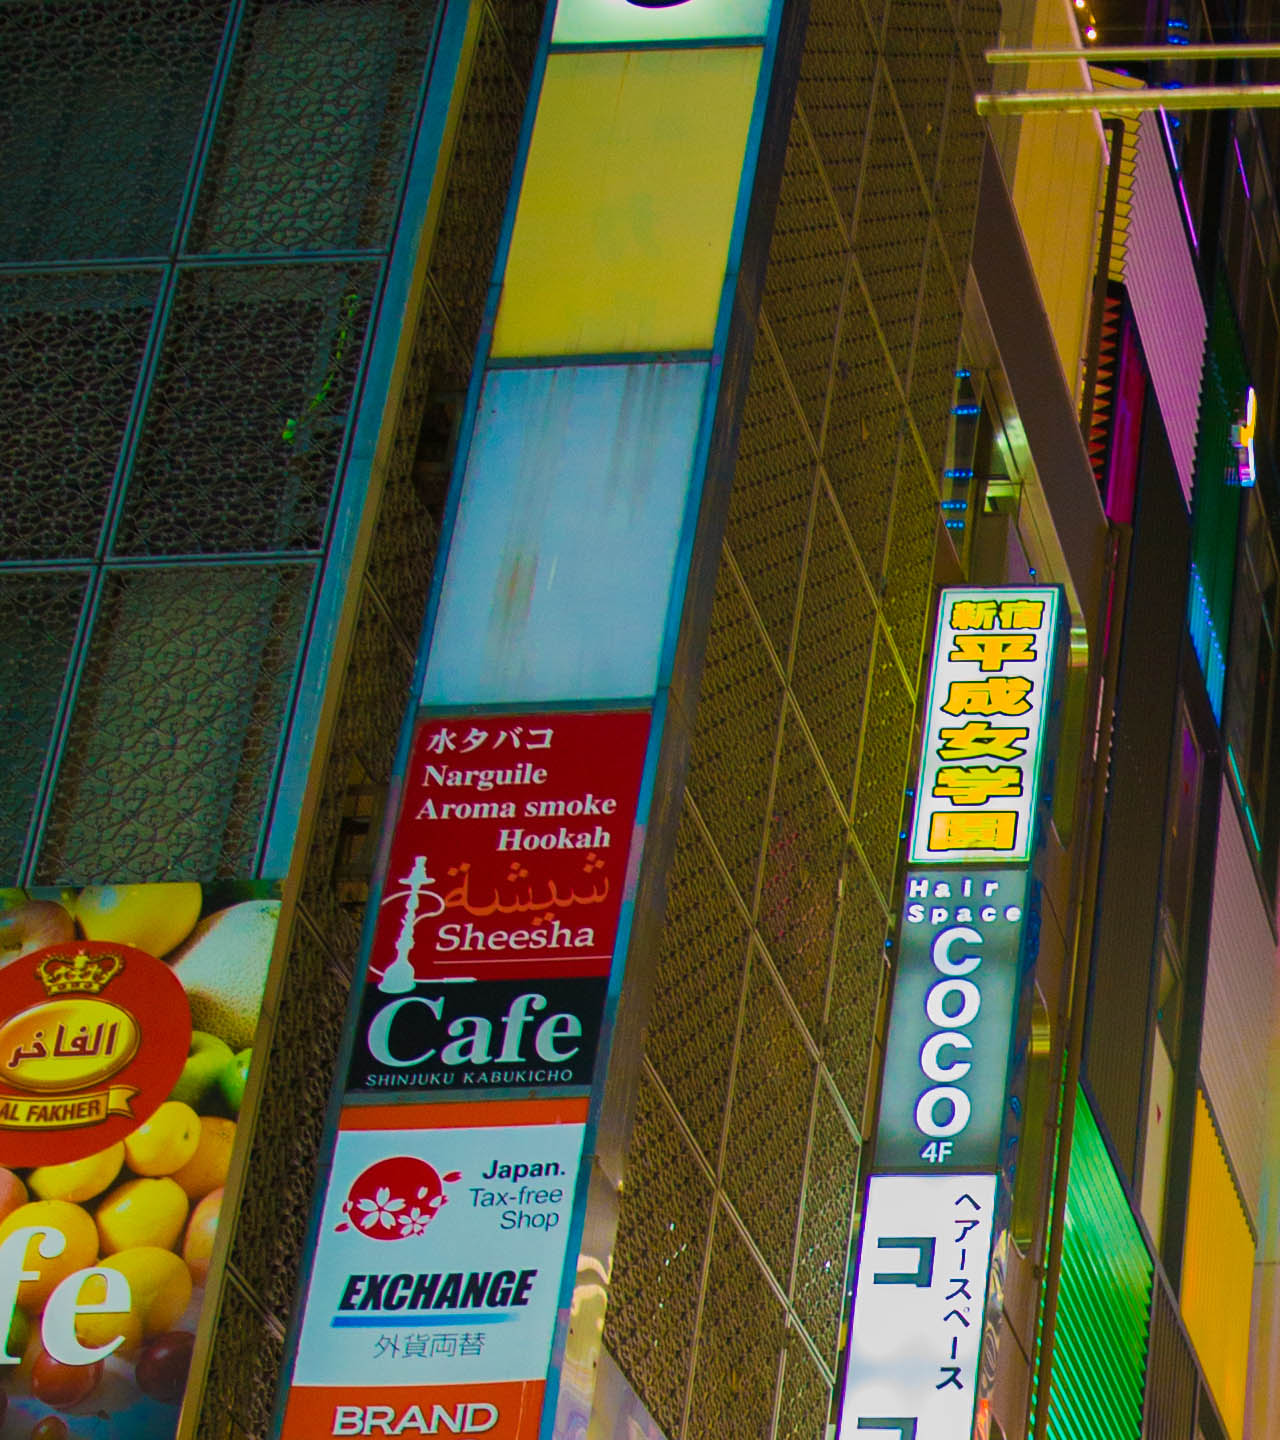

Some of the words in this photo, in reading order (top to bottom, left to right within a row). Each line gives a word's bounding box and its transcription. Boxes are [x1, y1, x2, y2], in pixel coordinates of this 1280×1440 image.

[949, 600, 1045, 630] 新宿
[426, 727, 554, 755] 水タバコ
[422, 762, 548, 791] Narguile
[416, 797, 516, 820] Aroma
[524, 794, 617, 818] smoke
[496, 826, 610, 852] Hookah
[908, 878, 999, 900] Hair
[906, 902, 1022, 925] Space
[435, 920, 595, 952] Sheesha
[367, 992, 582, 1067] Cafe
[914, 926, 984, 1138] COCO
[365, 1072, 455, 1087] SHINJUKU
[463, 1068, 573, 1084] KABUKICHO
[26, 1100, 100, 1122] FAKHER
[921, 1141, 953, 1164] 4F
[482, 1158, 566, 1183] Japan.
[469, 1186, 564, 1208] Tax-free
[499, 1210, 560, 1232] Shop
[337, 1268, 538, 1312] EXCHANGE
[935, 1192, 982, 1390] ヘアースペース
[372, 1331, 487, 1360] 外貨両替
[331, 1402, 499, 1437] BRAND
